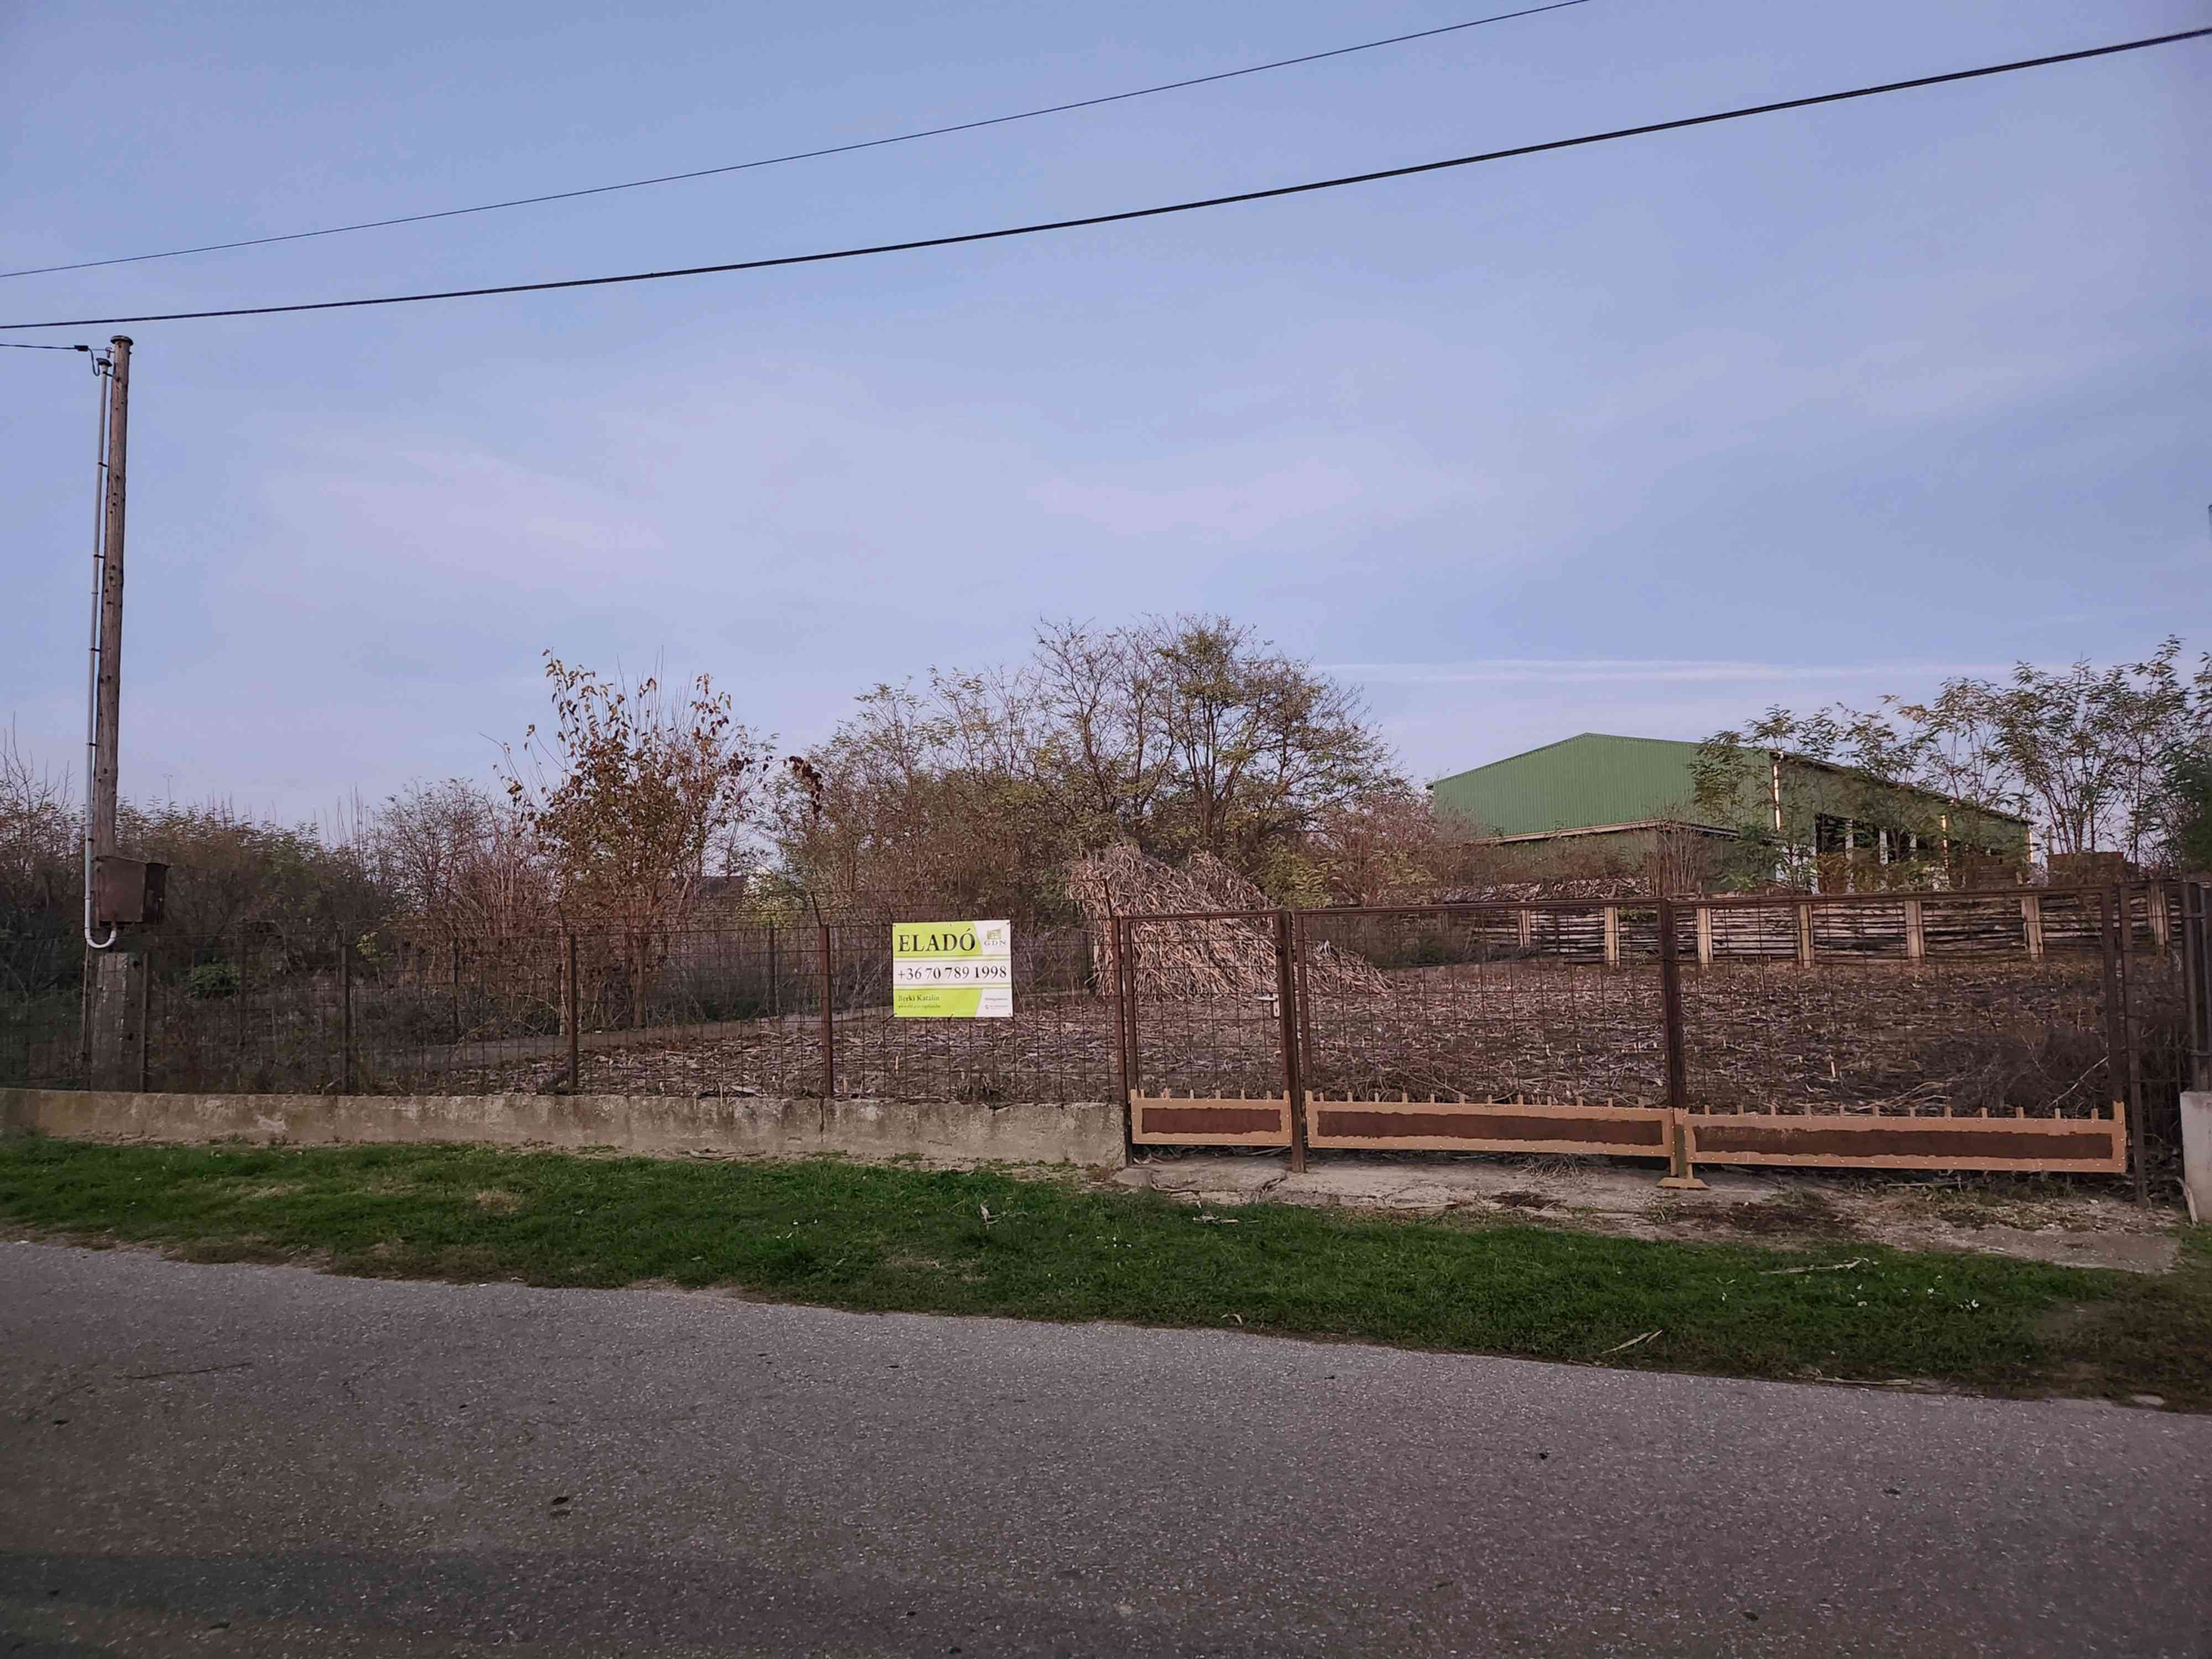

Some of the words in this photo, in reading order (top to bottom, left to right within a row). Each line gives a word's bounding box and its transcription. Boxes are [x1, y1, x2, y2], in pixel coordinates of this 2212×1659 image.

[898, 928, 975, 952] ELADÓ
[898, 967, 921, 980] +36
[925, 967, 941, 979] 70
[945, 967, 969, 979] 789
[974, 966, 1007, 979] 1998
